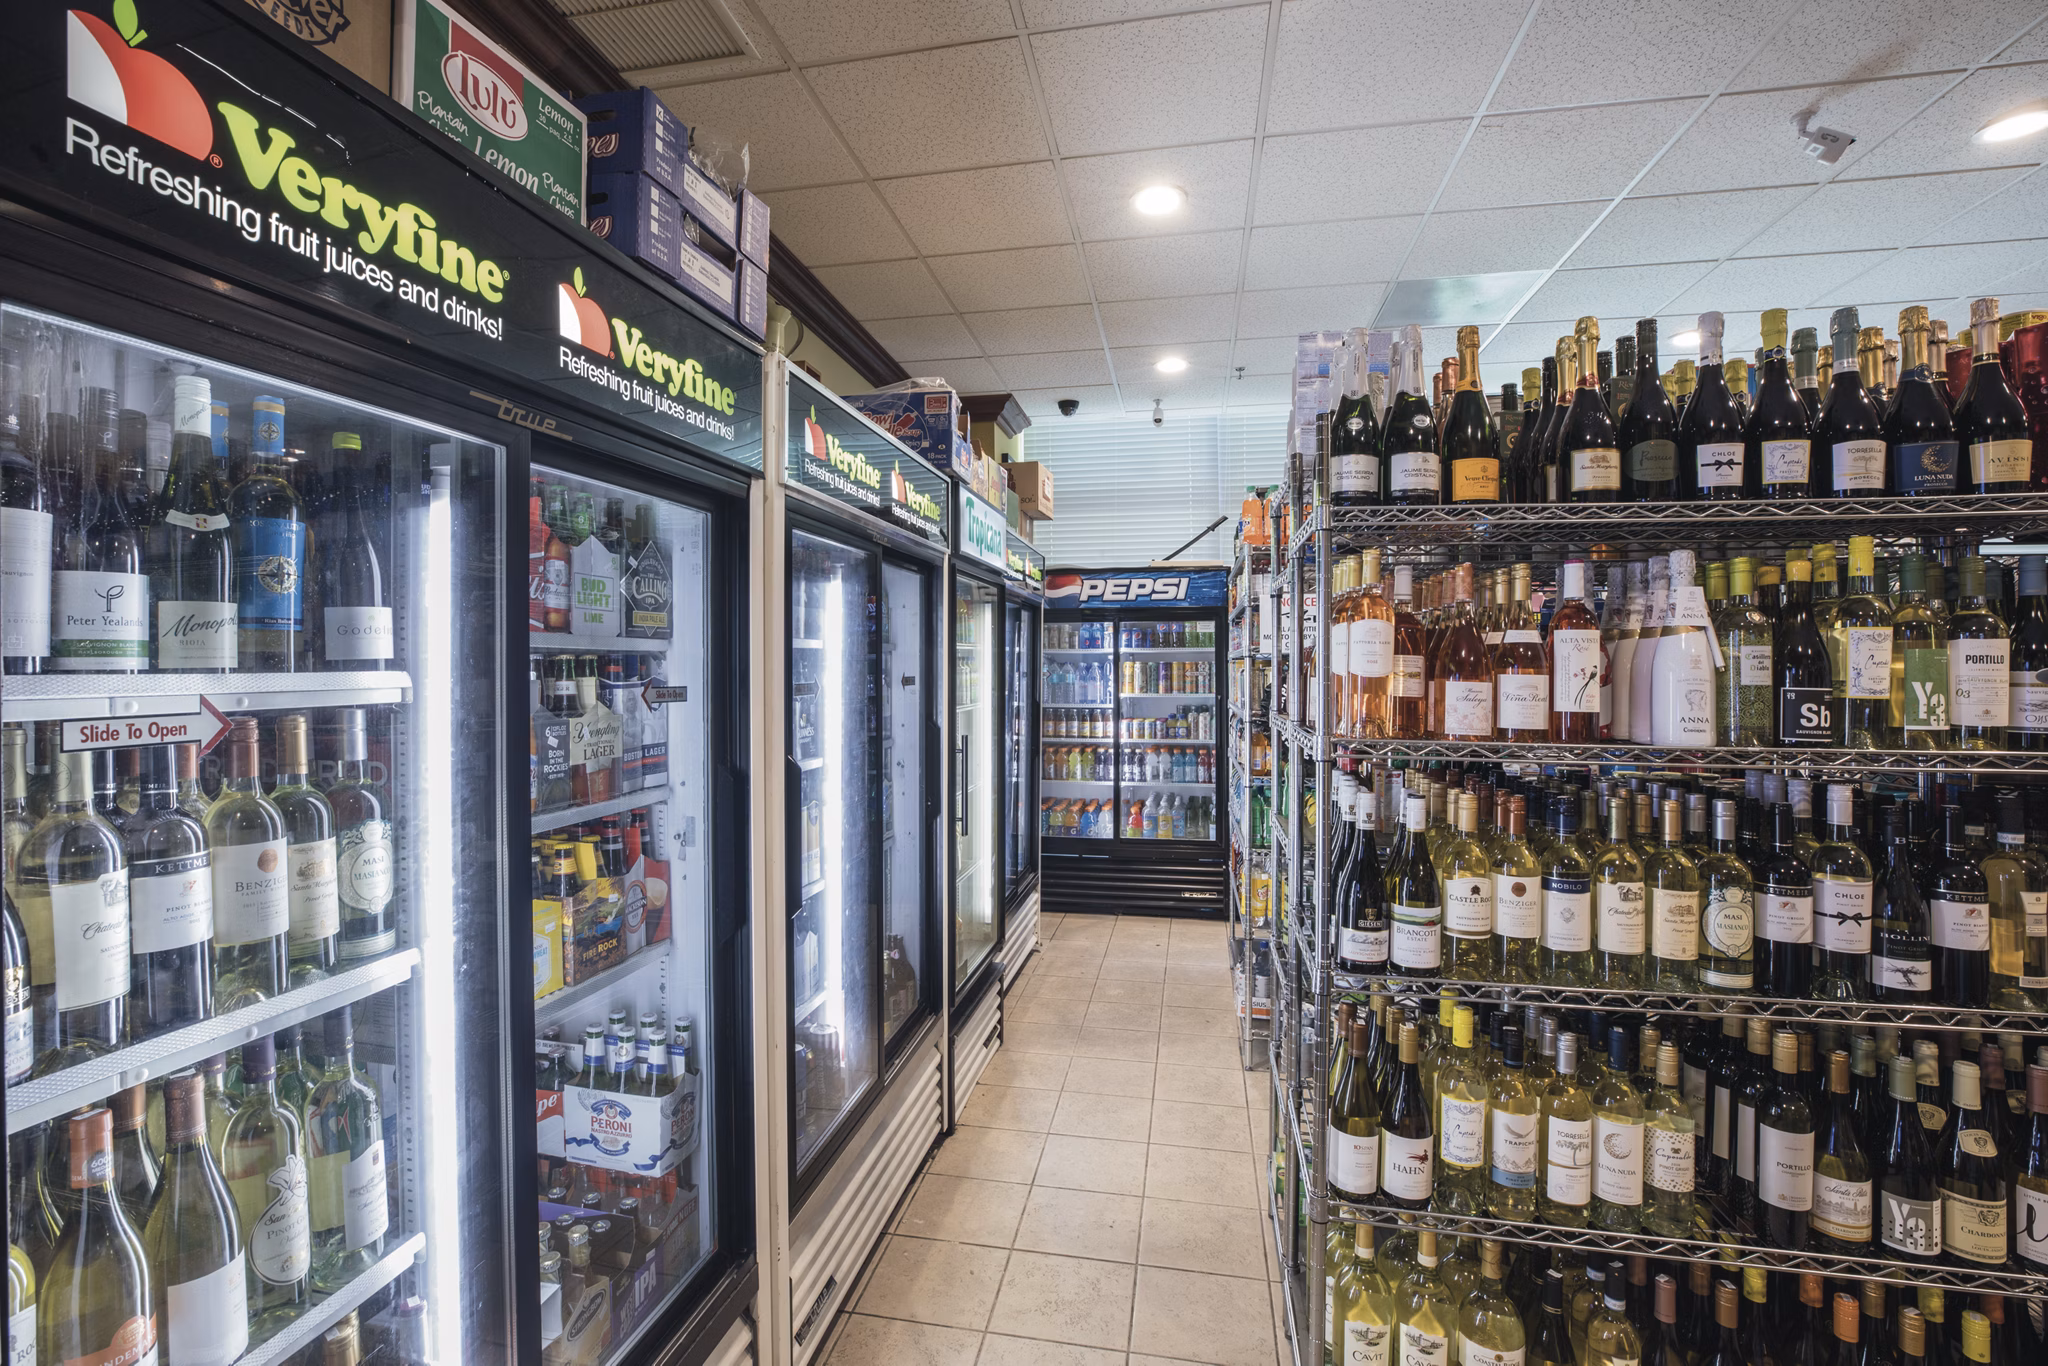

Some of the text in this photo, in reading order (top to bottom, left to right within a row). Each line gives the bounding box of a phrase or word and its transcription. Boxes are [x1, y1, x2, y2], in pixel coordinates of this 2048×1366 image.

[417, 90, 469, 137] Plantain
[538, 97, 575, 134] Lemon
[474, 135, 539, 195] Lemon
[542, 172, 580, 208] Plantain
[217, 101, 505, 304] Veryfine
[65, 116, 503, 341] Refreshing fruit juices and drinks!
[611, 317, 735, 416] Veryfine
[559, 345, 735, 442] Refreshing fruit juices and drinks!
[825, 433, 881, 490] Veryfine
[804, 458, 834, 489] Refreshing
[834, 475, 845, 490] fruit
[844, 478, 858, 497] juices
[857, 487, 867, 501] and
[1914, 474, 1936, 482] LUNA
[904, 480, 941, 522] Veryfine
[965, 496, 1002, 559] Tropicana
[581, 577, 606, 593] BUD
[632, 576, 667, 603] CALLING
[1079, 577, 1190, 601] PEPSI
[576, 591, 611, 608] LIGHT
[645, 596, 656, 605] IPA
[66, 615, 144, 627] Peter Yealands
[583, 613, 604, 624] LIME
[1965, 654, 2005, 665] PORTILLO
[655, 690, 684, 700] Slide To Open
[1502, 690, 1548, 703] Viña Real
[1911, 681, 1946, 728] Y3
[1679, 716, 1710, 724] ANNA
[1800, 702, 1831, 727] Sb
[80, 721, 188, 743] Slide To Open
[545, 726, 551, 737] 6
[548, 750, 565, 758] BORN
[583, 744, 615, 761] LAGER
[624, 750, 643, 762] BOSTON
[644, 746, 666, 758] LAGER
[543, 763, 569, 774] ROCKIES
[543, 843, 555, 851] THE
[362, 856, 385, 867] MASI
[1551, 882, 1582, 890] NOBILO
[1763, 886, 1809, 896] KETTMEIR
[241, 889, 267, 897] FAMILY
[1449, 894, 1479, 903] CASTLE
[1834, 892, 1865, 900] CHLOE
[1499, 896, 1537, 907] BENZIGER
[166, 903, 192, 913] PINOT
[1723, 913, 1743, 921] MASI
[1396, 926, 1437, 937] BRANCOTT
[1716, 922, 1749, 931] MASIANCO
[582, 937, 618, 961] FIRE ROCK
[591, 1115, 632, 1133] PERONI
[1557, 1130, 1590, 1139] TORRESELLA
[1503, 1139, 1535, 1147] TRAPICHE
[1393, 1162, 1425, 1175] HAHN
[1598, 1163, 1636, 1176] LUNA NUDA
[1776, 1161, 1812, 1171] PORTILLO
[1825, 1185, 1868, 1198] Santa Rita
[1888, 1197, 1926, 1251] Y3
[1832, 1226, 1865, 1235] CHARDONNAY
[634, 1261, 657, 1309] IPA
[571, 1292, 603, 1337] STRONGBOW
[1352, 1350, 1384, 1362] CAVIT
